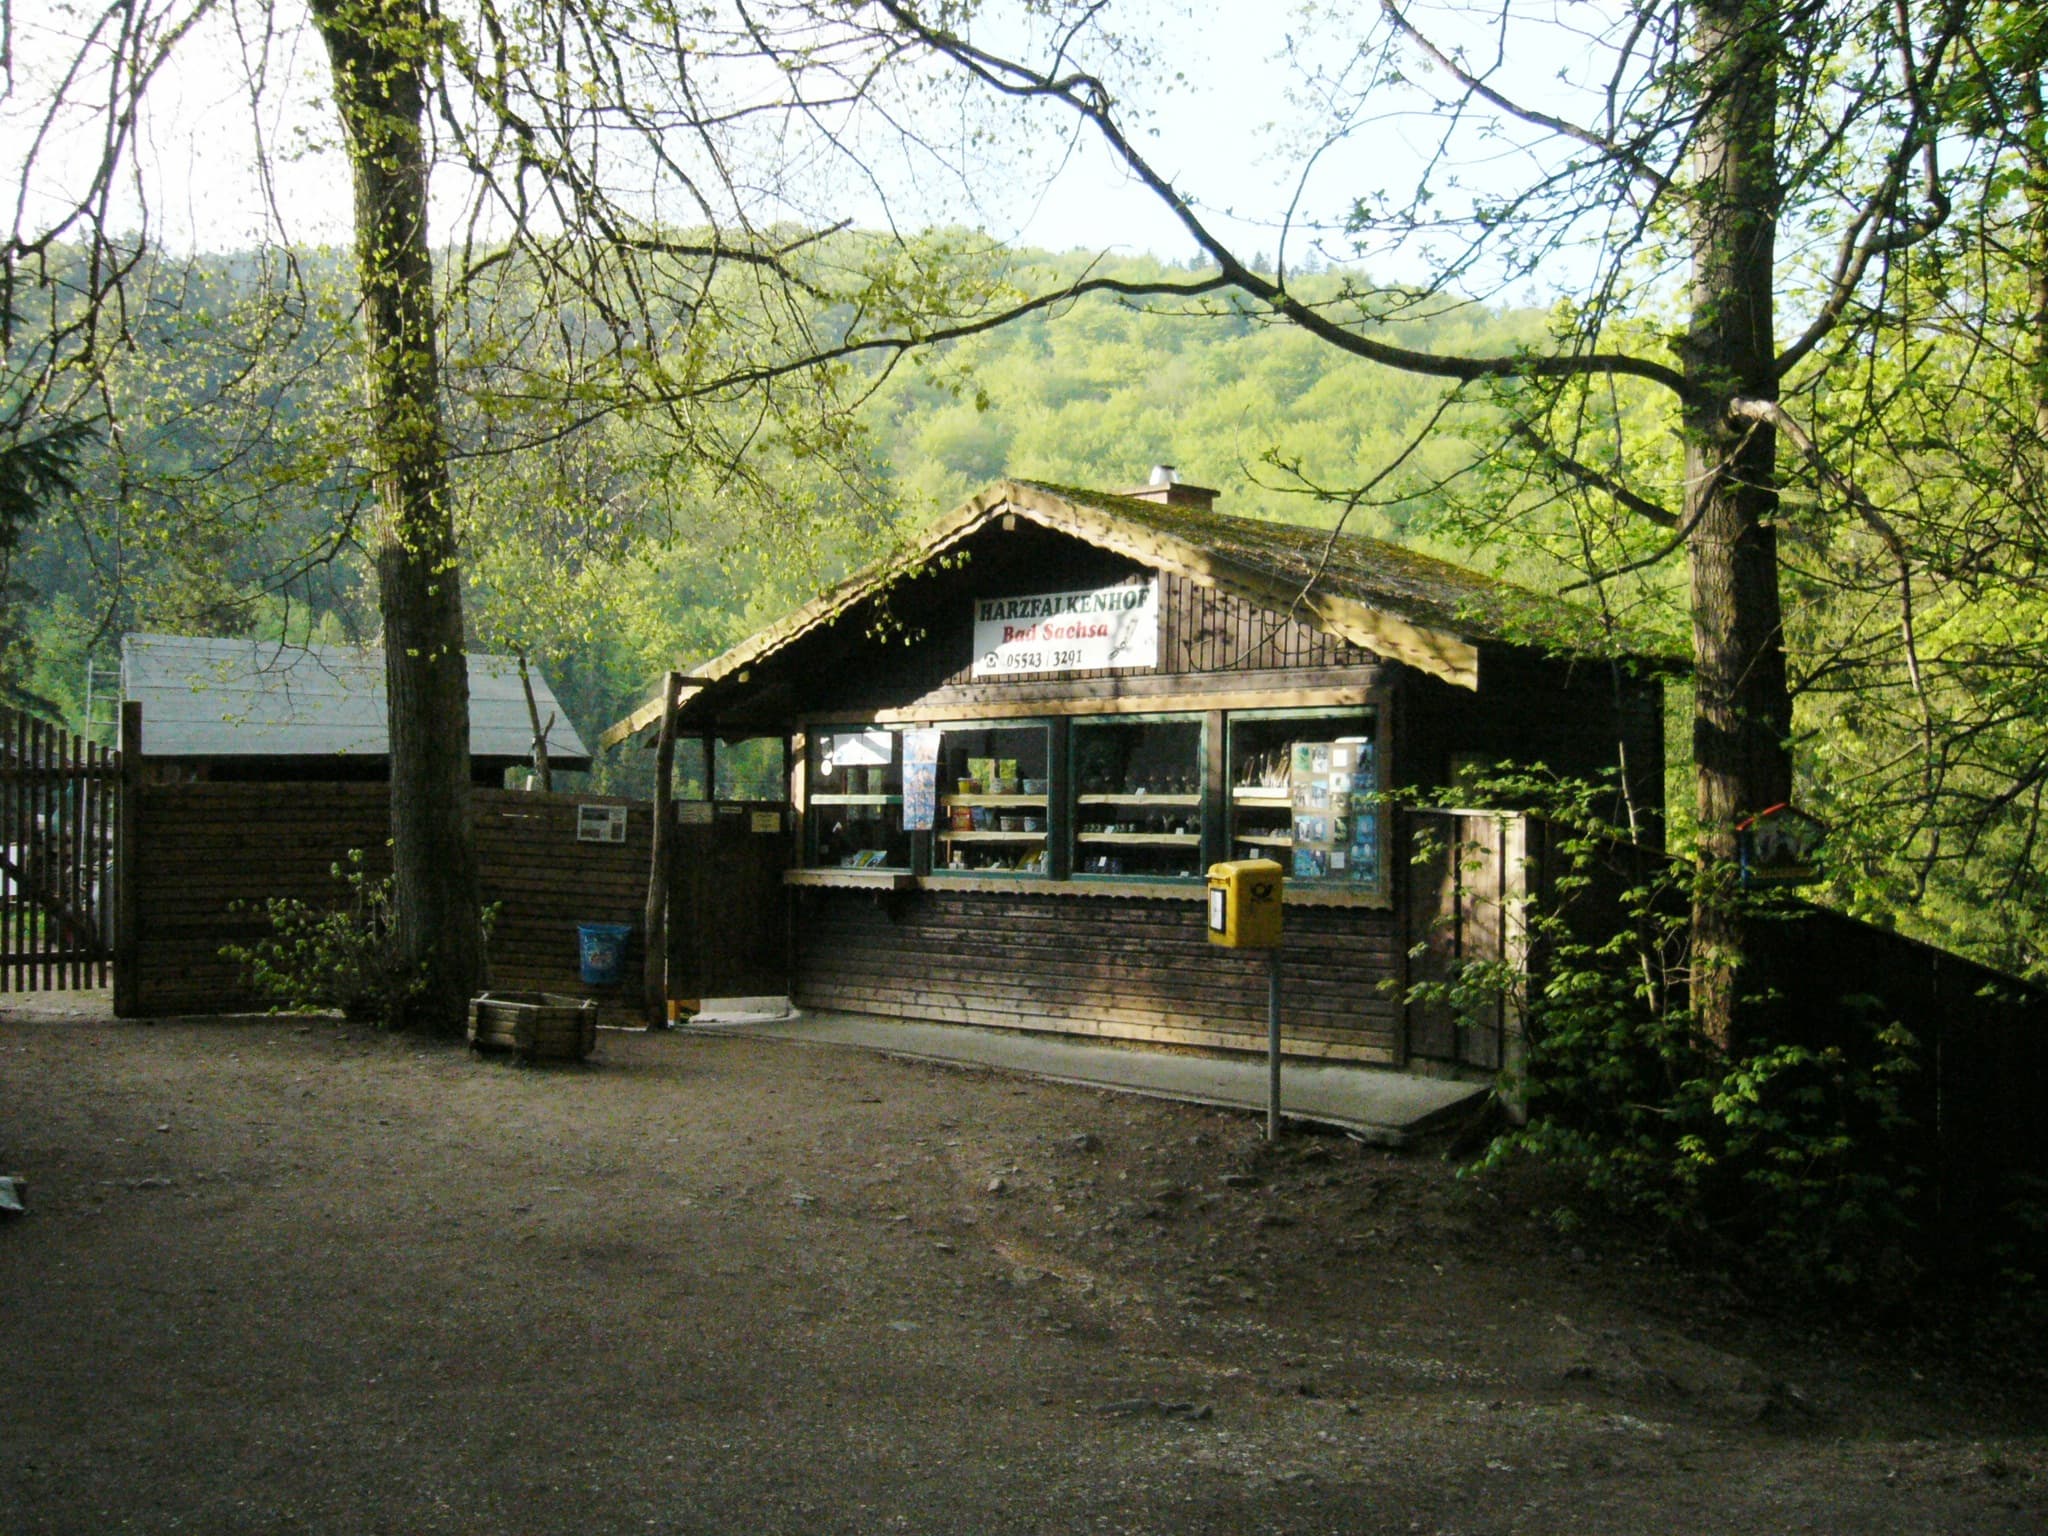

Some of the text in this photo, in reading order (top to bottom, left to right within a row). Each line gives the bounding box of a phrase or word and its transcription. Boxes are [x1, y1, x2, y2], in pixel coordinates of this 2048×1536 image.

[980, 586, 1150, 622] HARZFALKENHOF
[1002, 621, 1108, 643] Bad Sachsa
[1006, 653, 1042, 668] 05523
[1053, 650, 1082, 667] 3291
